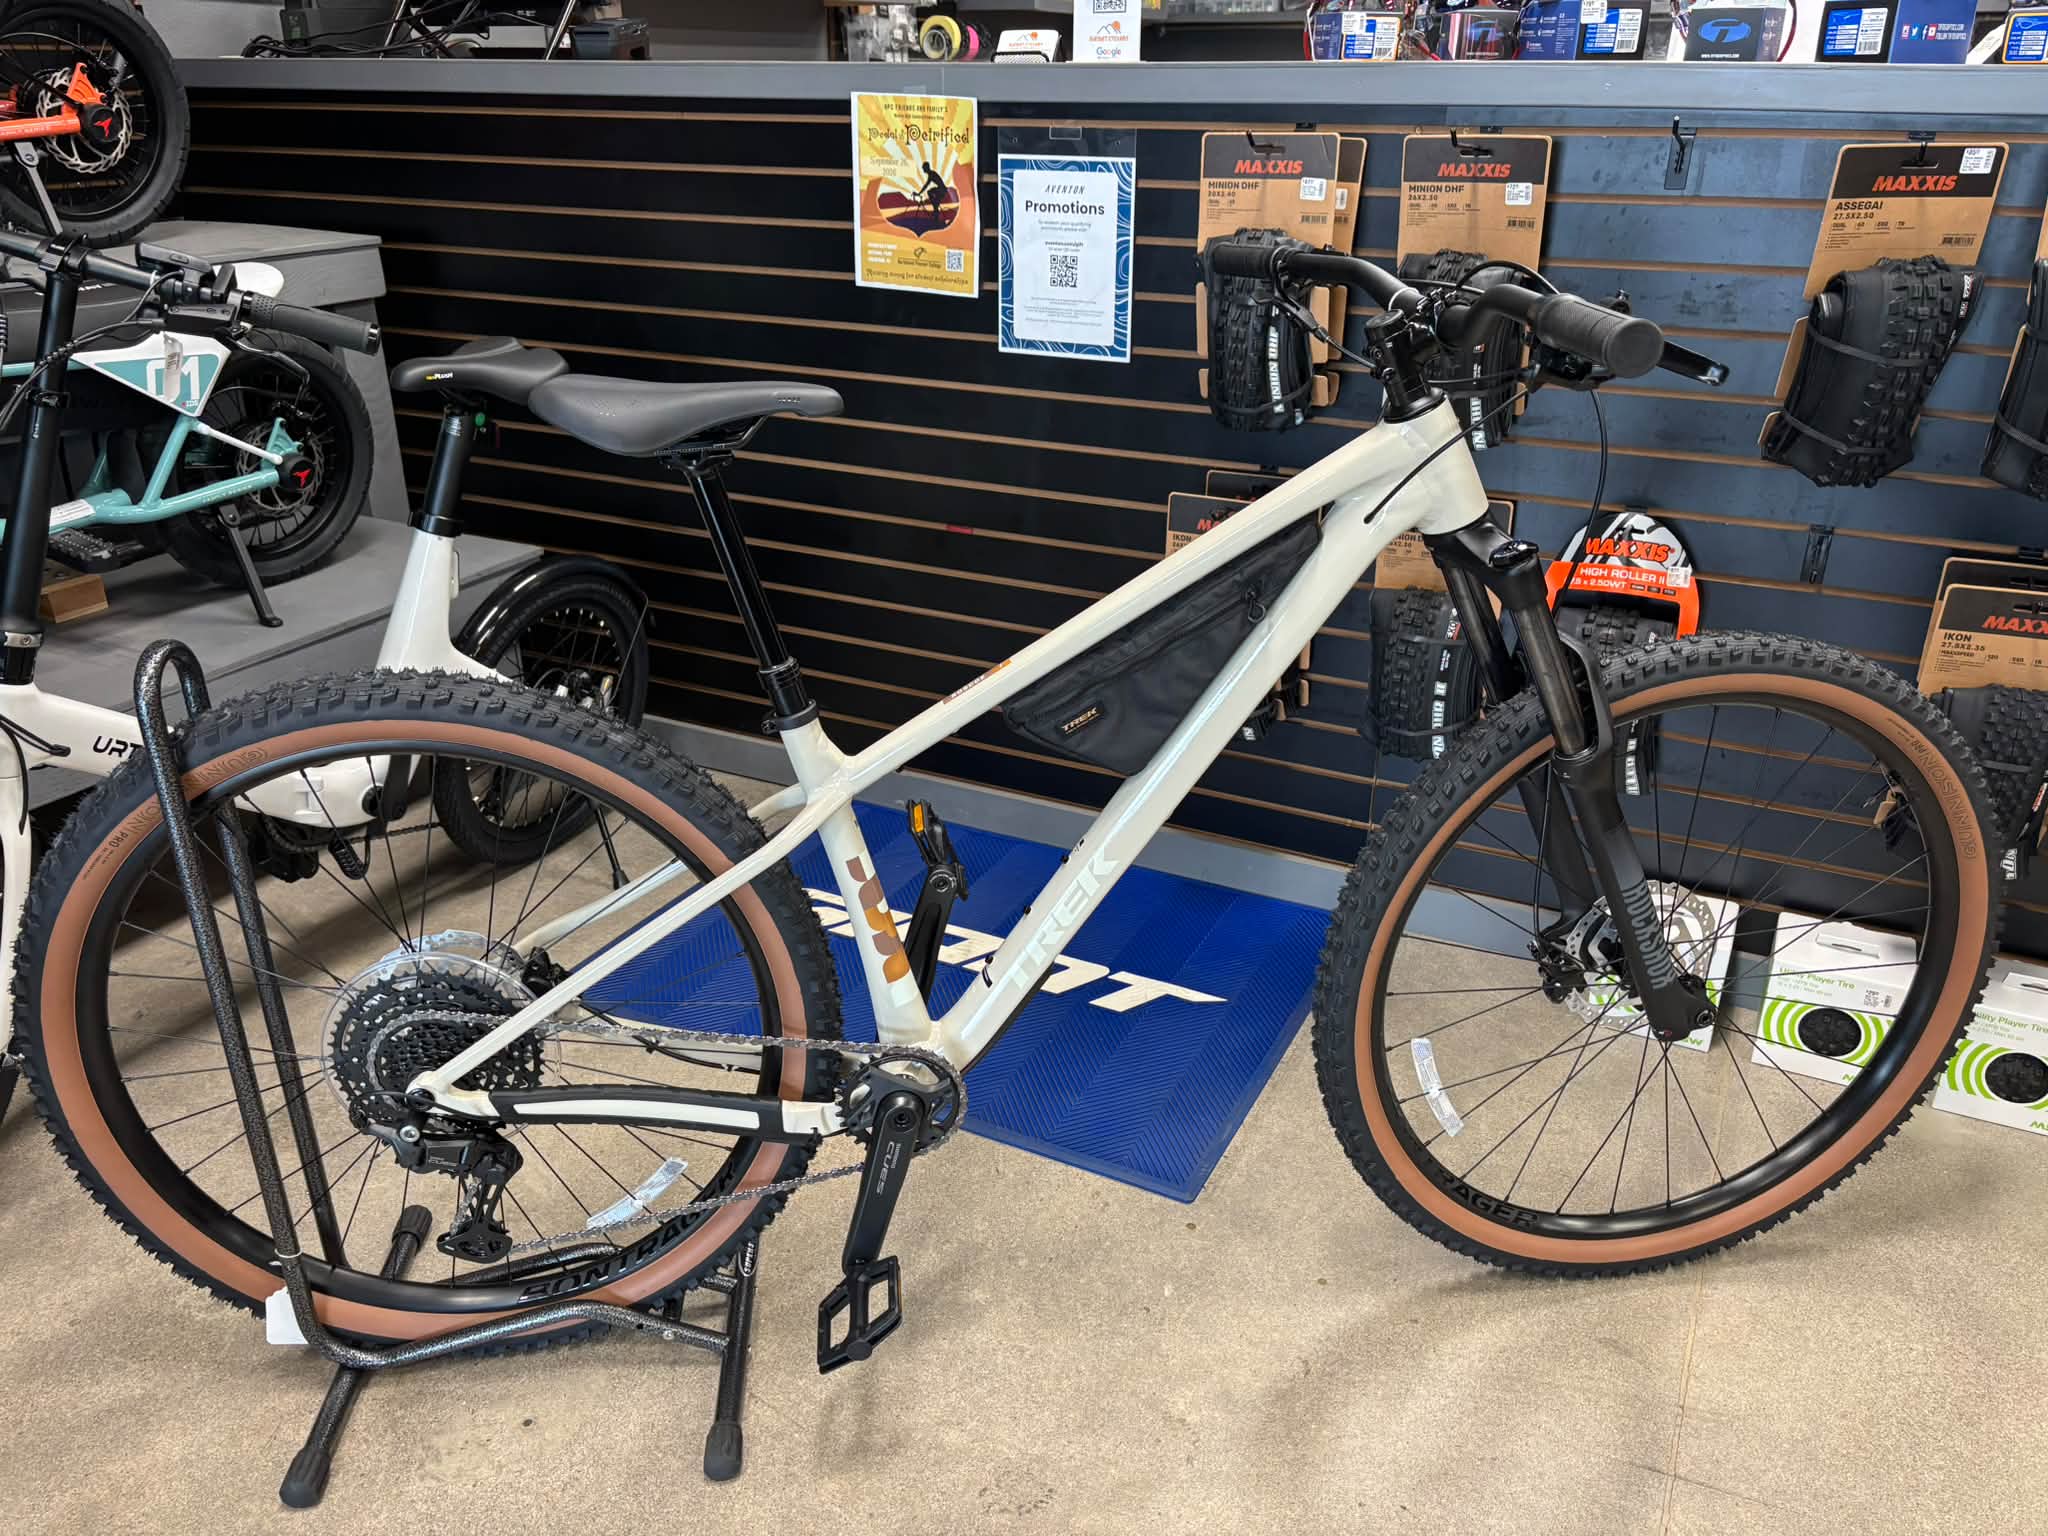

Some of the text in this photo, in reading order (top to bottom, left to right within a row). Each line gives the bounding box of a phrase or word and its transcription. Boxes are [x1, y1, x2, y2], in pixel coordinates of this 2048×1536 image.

[1096, 46, 1121, 57] Google
[905, 124, 969, 147] Petrified
[1234, 160, 1304, 175] MAXXIS
[1437, 162, 1512, 178] MAXXIS
[1208, 181, 1240, 189] MINION
[1408, 184, 1465, 193] MINION DHF
[1871, 175, 1959, 192] MAXXIS
[1025, 199, 1105, 215] Promotions
[1835, 201, 1884, 211] ASSEGAI
[1580, 567, 1608, 577] HIGH
[1611, 569, 1657, 582] ROLLER
[1943, 632, 1972, 642] IKON
[1061, 706, 1098, 732] TREK
[108, 831, 129, 848] PRO
[1006, 848, 1121, 990] TREK
[1621, 881, 1678, 990] ROCKSHOX
[1806, 973, 1835, 986] Player
[1838, 980, 1855, 990] Tire
[1998, 1015, 2029, 1030] Player
[2031, 1021, 2048, 1033] Tire
[876, 1141, 895, 1195] CUES
